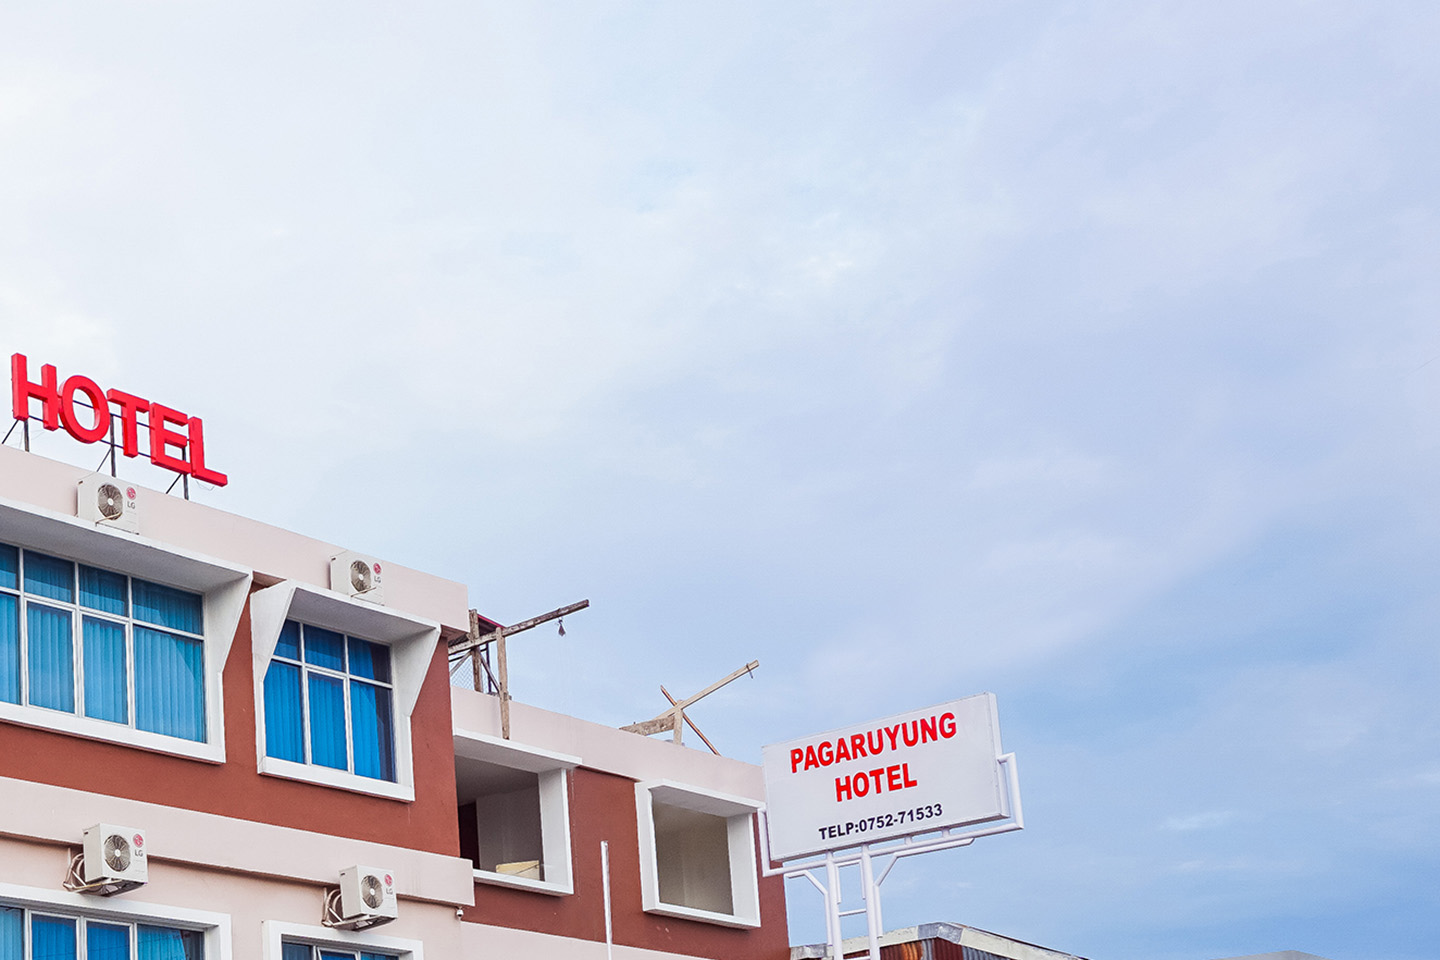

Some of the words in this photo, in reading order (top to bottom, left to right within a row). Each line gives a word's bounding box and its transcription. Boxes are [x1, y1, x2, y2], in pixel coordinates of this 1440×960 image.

[12, 354, 227, 486] HOTEL
[790, 712, 957, 774] PAGARUYUNG
[834, 762, 918, 802] HOTEL
[818, 803, 944, 841] TELP:0752-71533
[134, 849, 144, 857] LG
